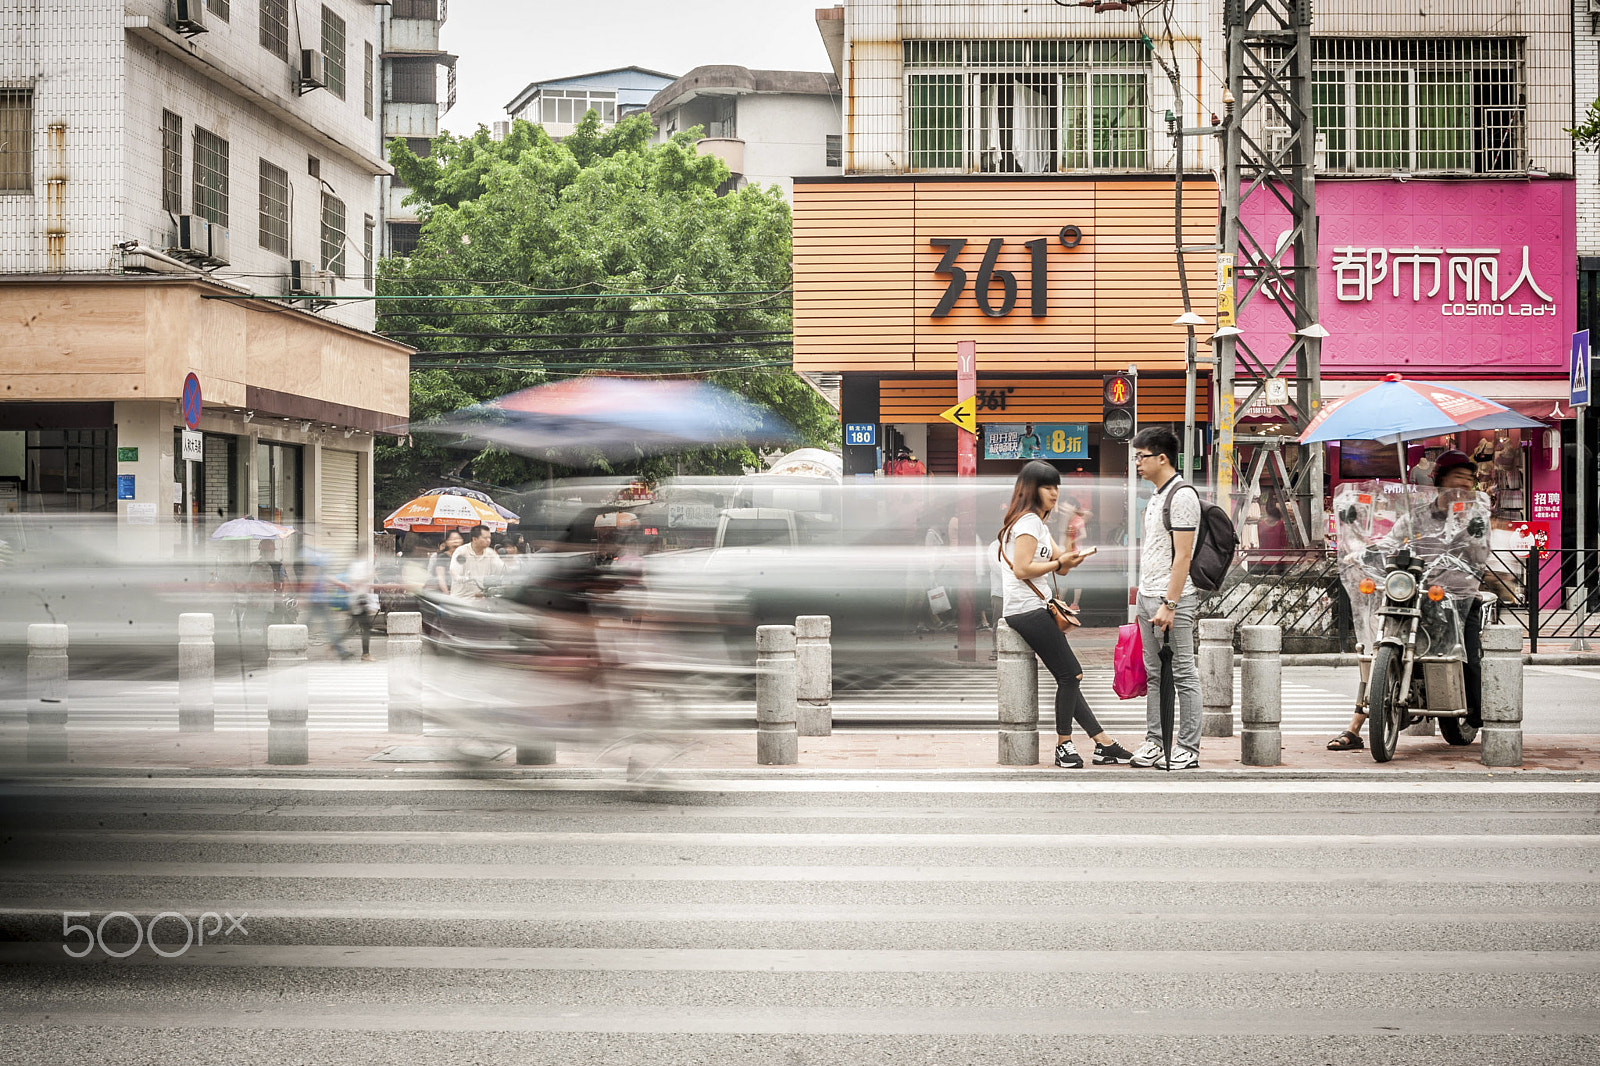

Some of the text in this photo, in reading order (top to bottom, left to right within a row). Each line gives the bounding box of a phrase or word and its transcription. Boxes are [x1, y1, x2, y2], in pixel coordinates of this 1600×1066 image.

[930, 224, 1082, 318] 361°
[1332, 245, 1553, 301] 都市丽人
[1441, 303, 1504, 316] COSMO
[1549, 401, 1565, 418] 人
[851, 431, 871, 443] 180
[1052, 430, 1082, 454] 8折
[1534, 492, 1560, 505] 招聘
